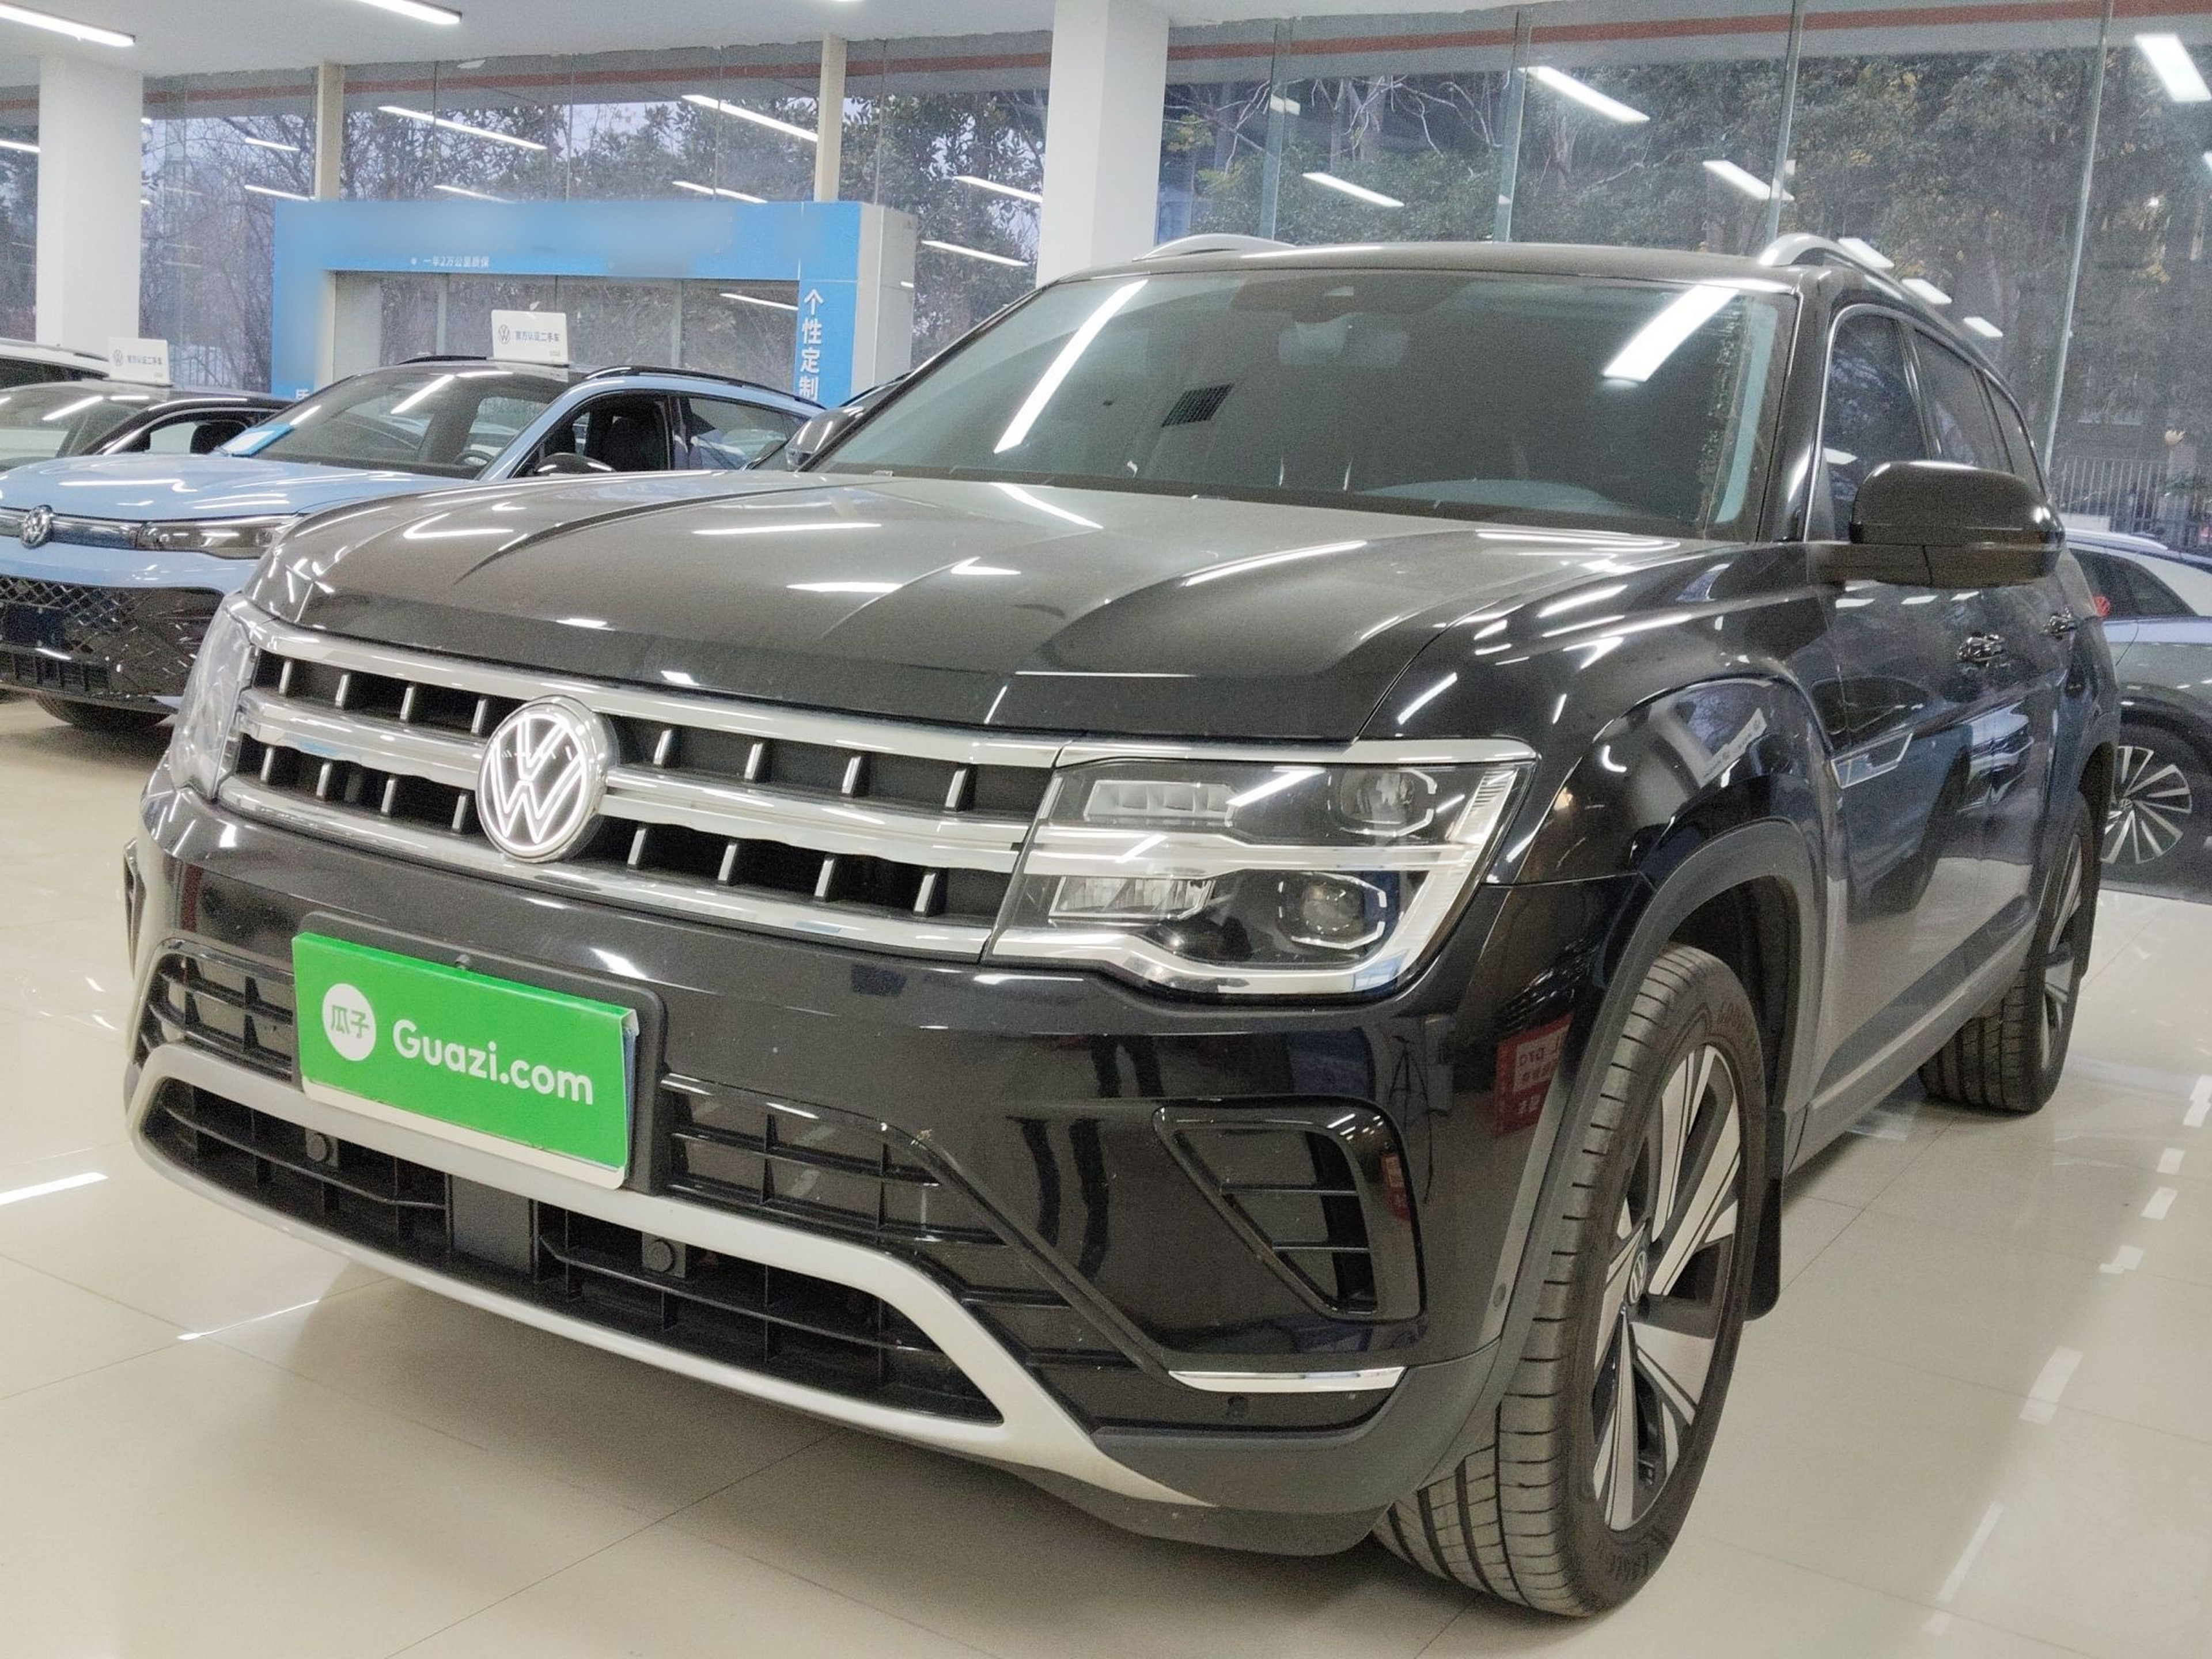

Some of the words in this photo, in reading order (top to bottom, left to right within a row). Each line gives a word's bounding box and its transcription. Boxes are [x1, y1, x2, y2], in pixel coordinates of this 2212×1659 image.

[798, 288, 824, 402] 个性定制
[482, 712, 586, 850] VW
[330, 1004, 370, 1039] 瓜子
[392, 1018, 594, 1105] Guazi.com
